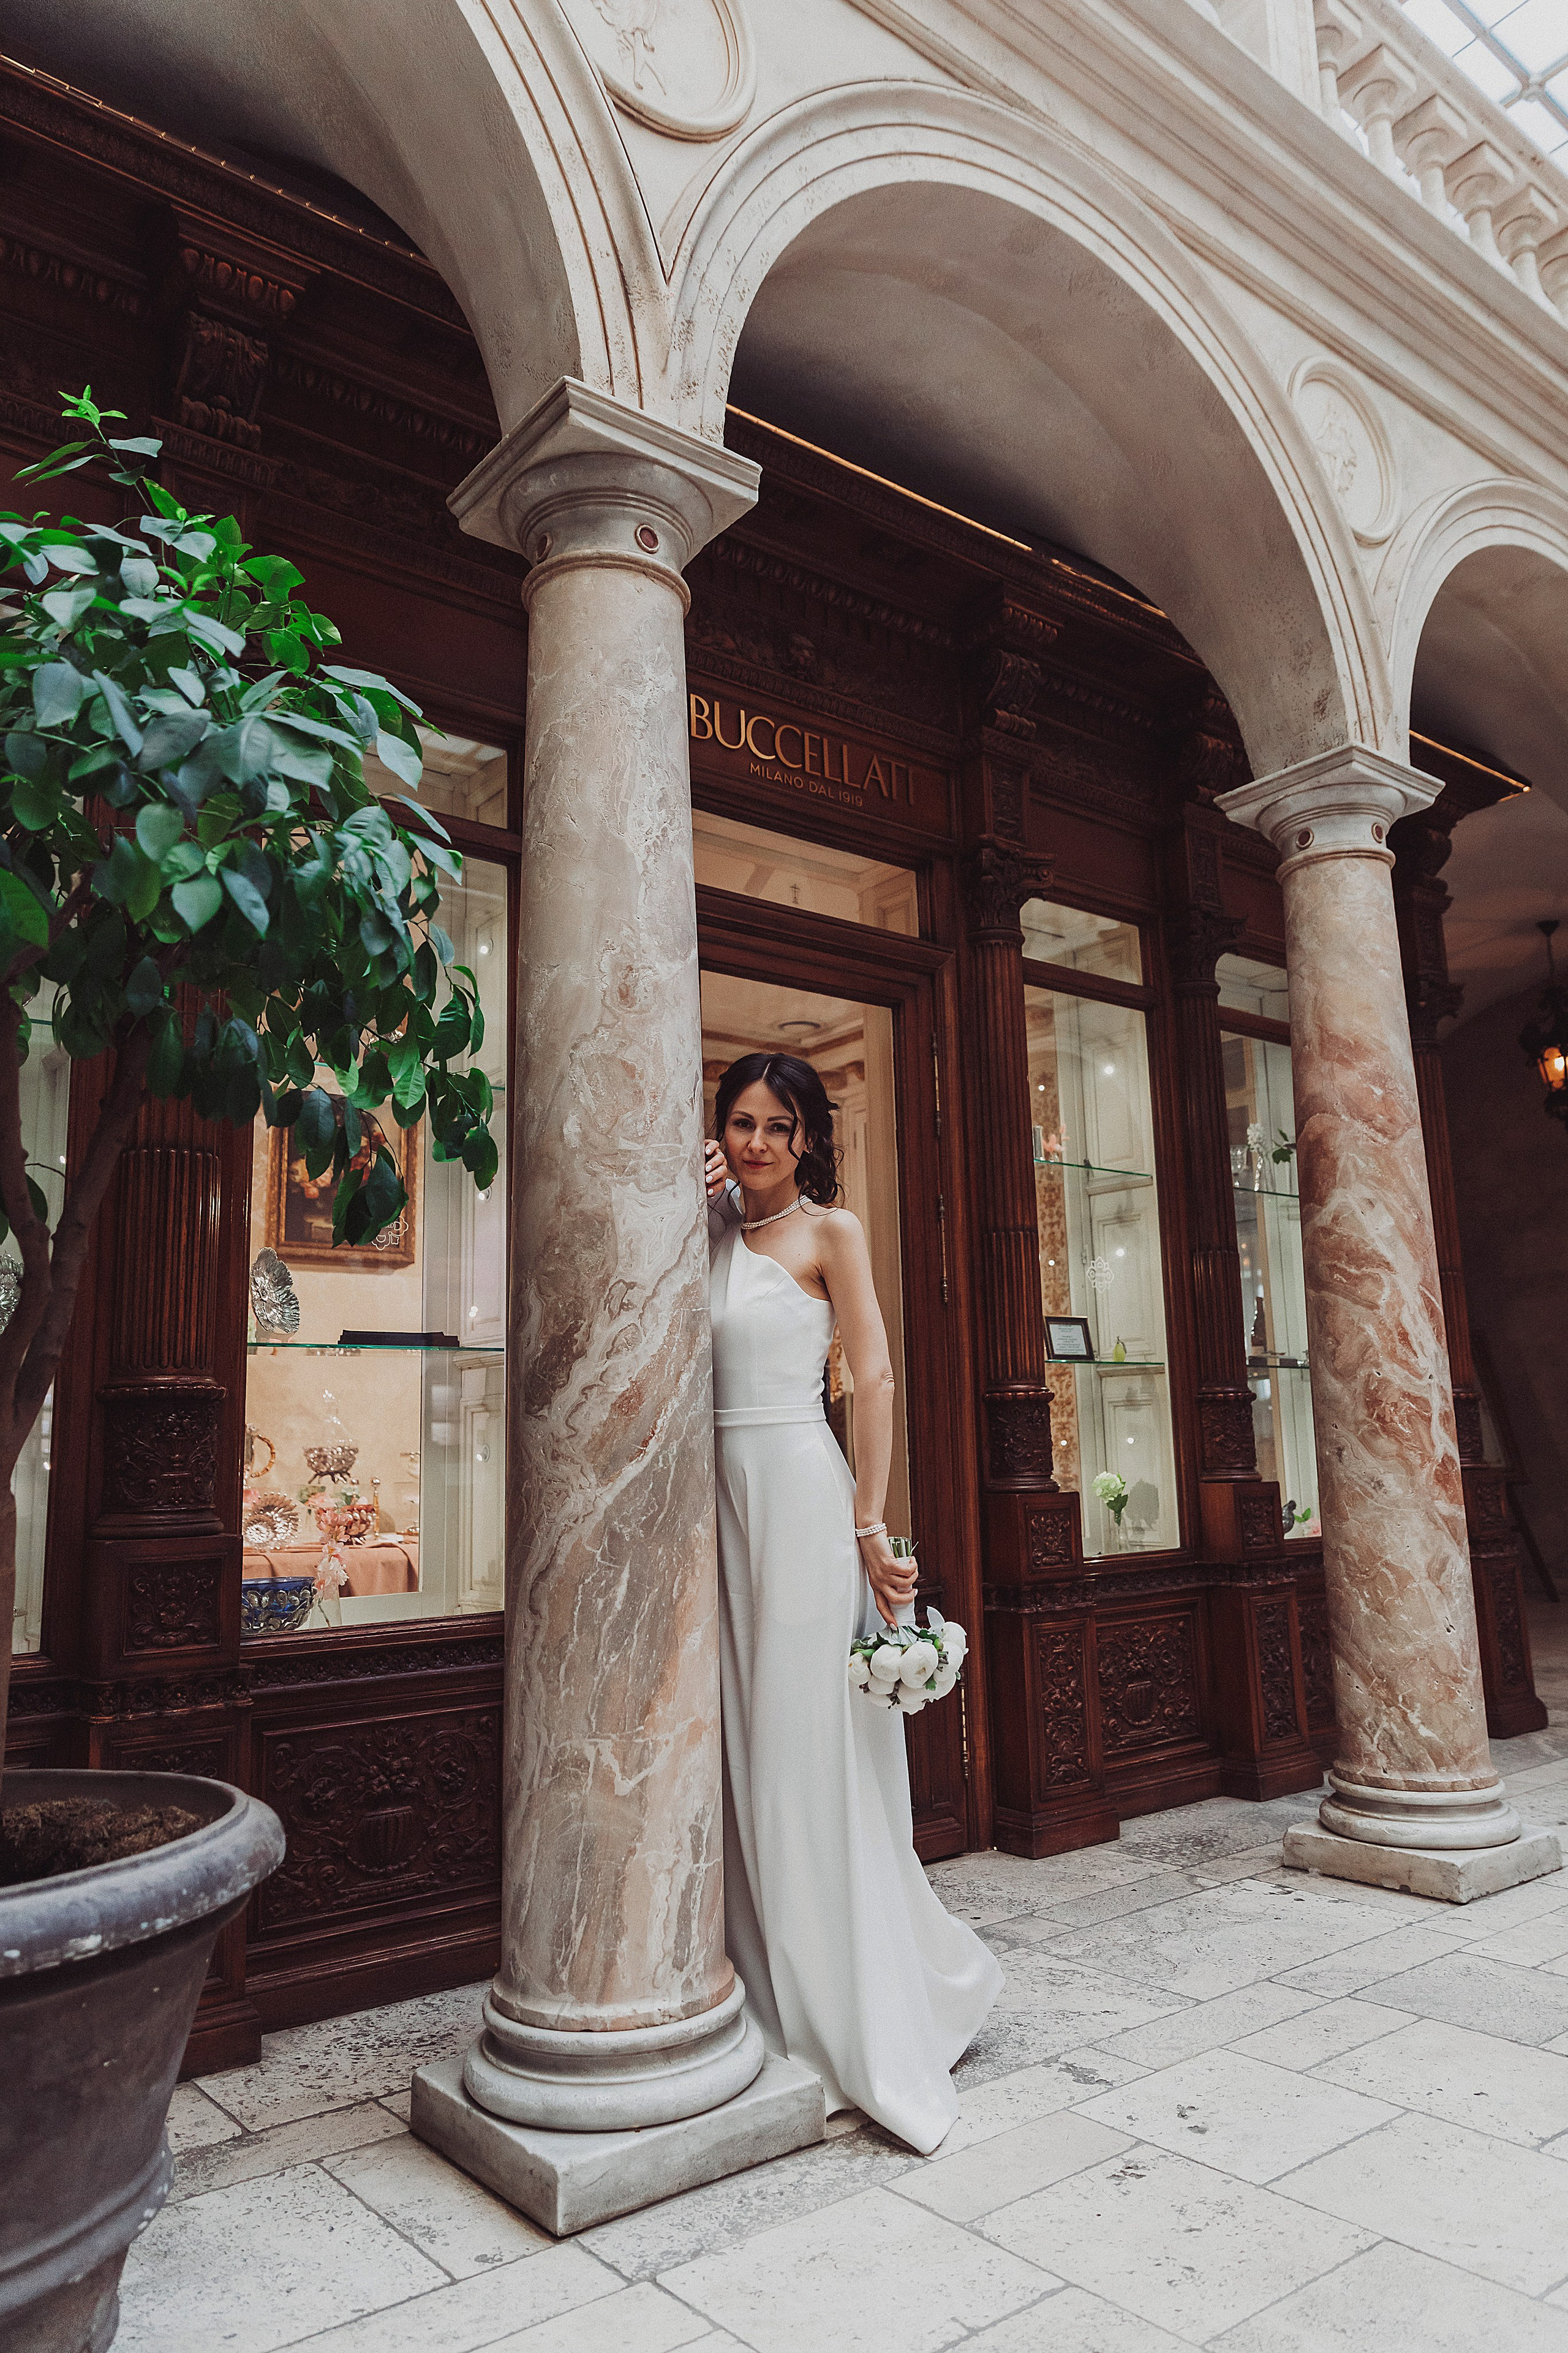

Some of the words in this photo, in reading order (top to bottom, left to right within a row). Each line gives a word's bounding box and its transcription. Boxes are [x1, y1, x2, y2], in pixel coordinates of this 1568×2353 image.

[690, 693, 914, 806] BUCCELLATI
[750, 762, 804, 789] MILANO
[809, 781, 834, 799] DAL
[839, 790, 863, 807] 1919
